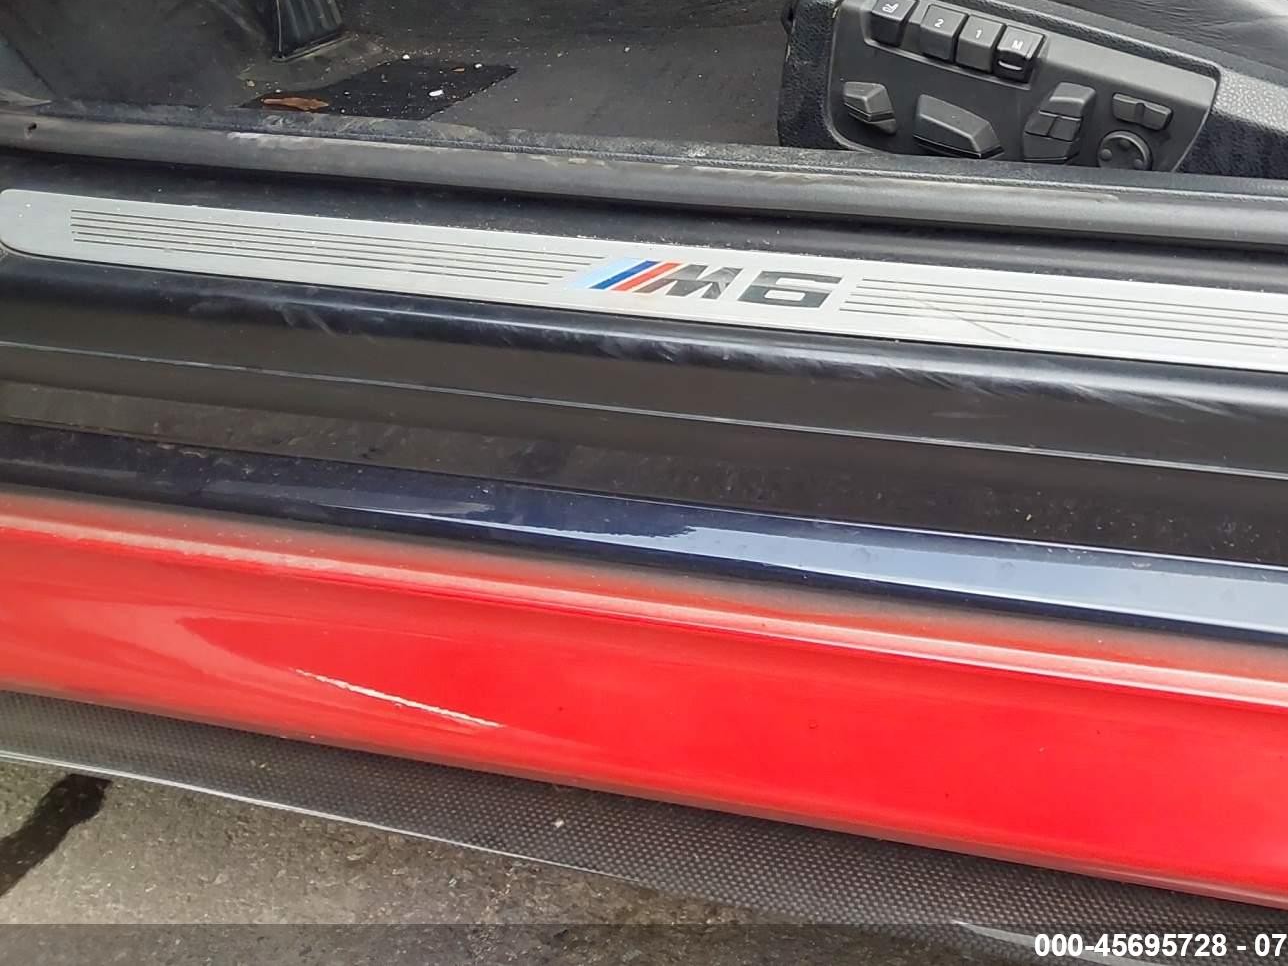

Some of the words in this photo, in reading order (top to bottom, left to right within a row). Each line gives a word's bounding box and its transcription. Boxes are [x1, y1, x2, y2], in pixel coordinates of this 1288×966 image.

[934, 18, 944, 28] 2
[975, 29, 984, 39] 1
[1011, 40, 1024, 51] M
[632, 263, 843, 309] M6
